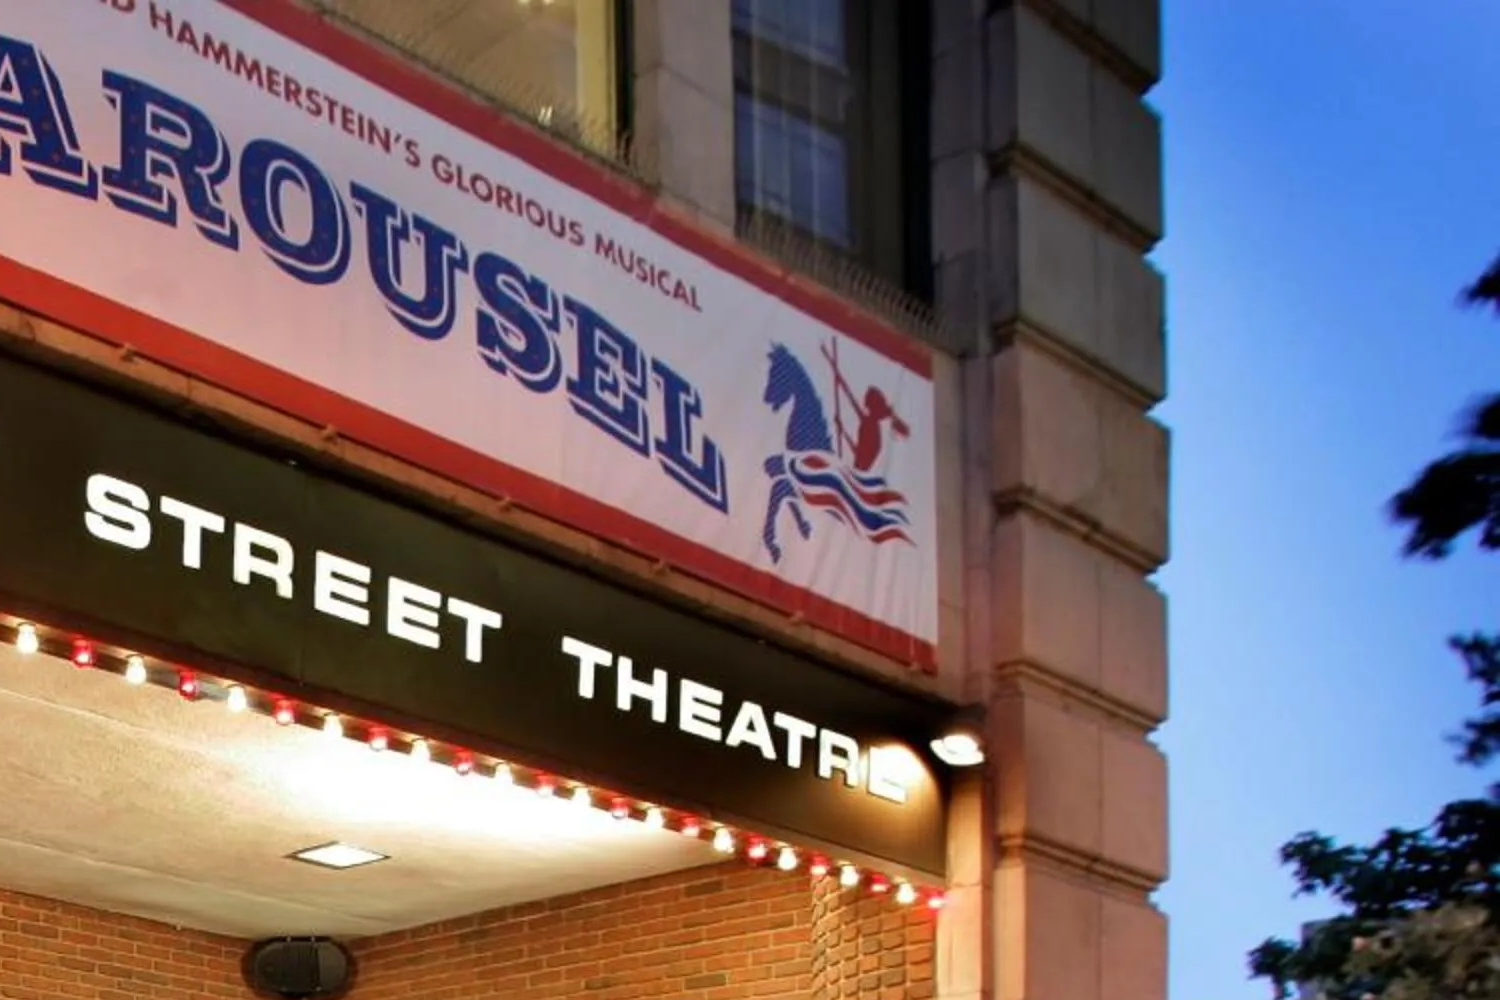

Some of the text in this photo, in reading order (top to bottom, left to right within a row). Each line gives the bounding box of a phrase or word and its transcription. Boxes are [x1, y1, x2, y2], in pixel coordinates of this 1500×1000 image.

[149, 0, 703, 312] HAMMERSTEIN'S GLORIOUS MUSICAL
[84, 473, 503, 664] STREET
